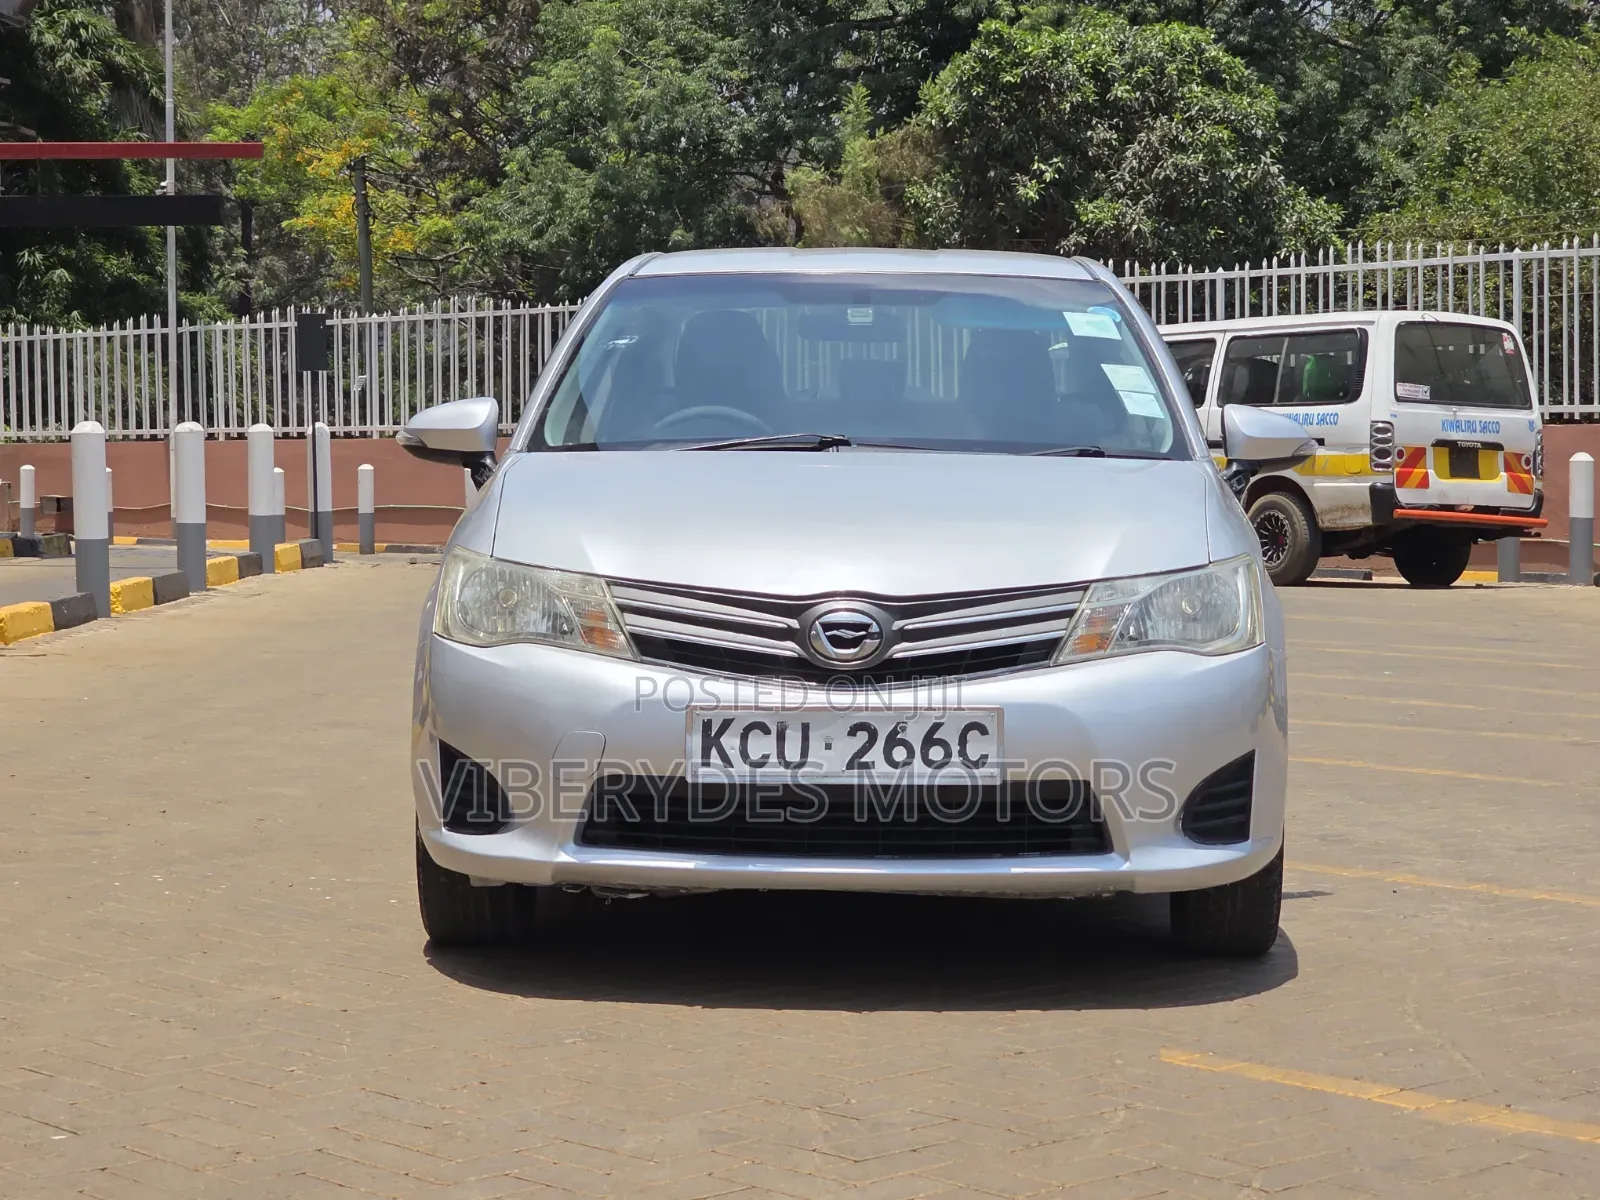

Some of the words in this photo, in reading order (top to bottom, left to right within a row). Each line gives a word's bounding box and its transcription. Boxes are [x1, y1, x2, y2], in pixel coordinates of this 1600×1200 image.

[1316, 412, 1339, 426] SACCO
[1441, 419, 1477, 434] KIWALIRU
[1479, 420, 1501, 434] SACCO
[701, 717, 811, 770] KCU
[846, 721, 990, 770] 266C
